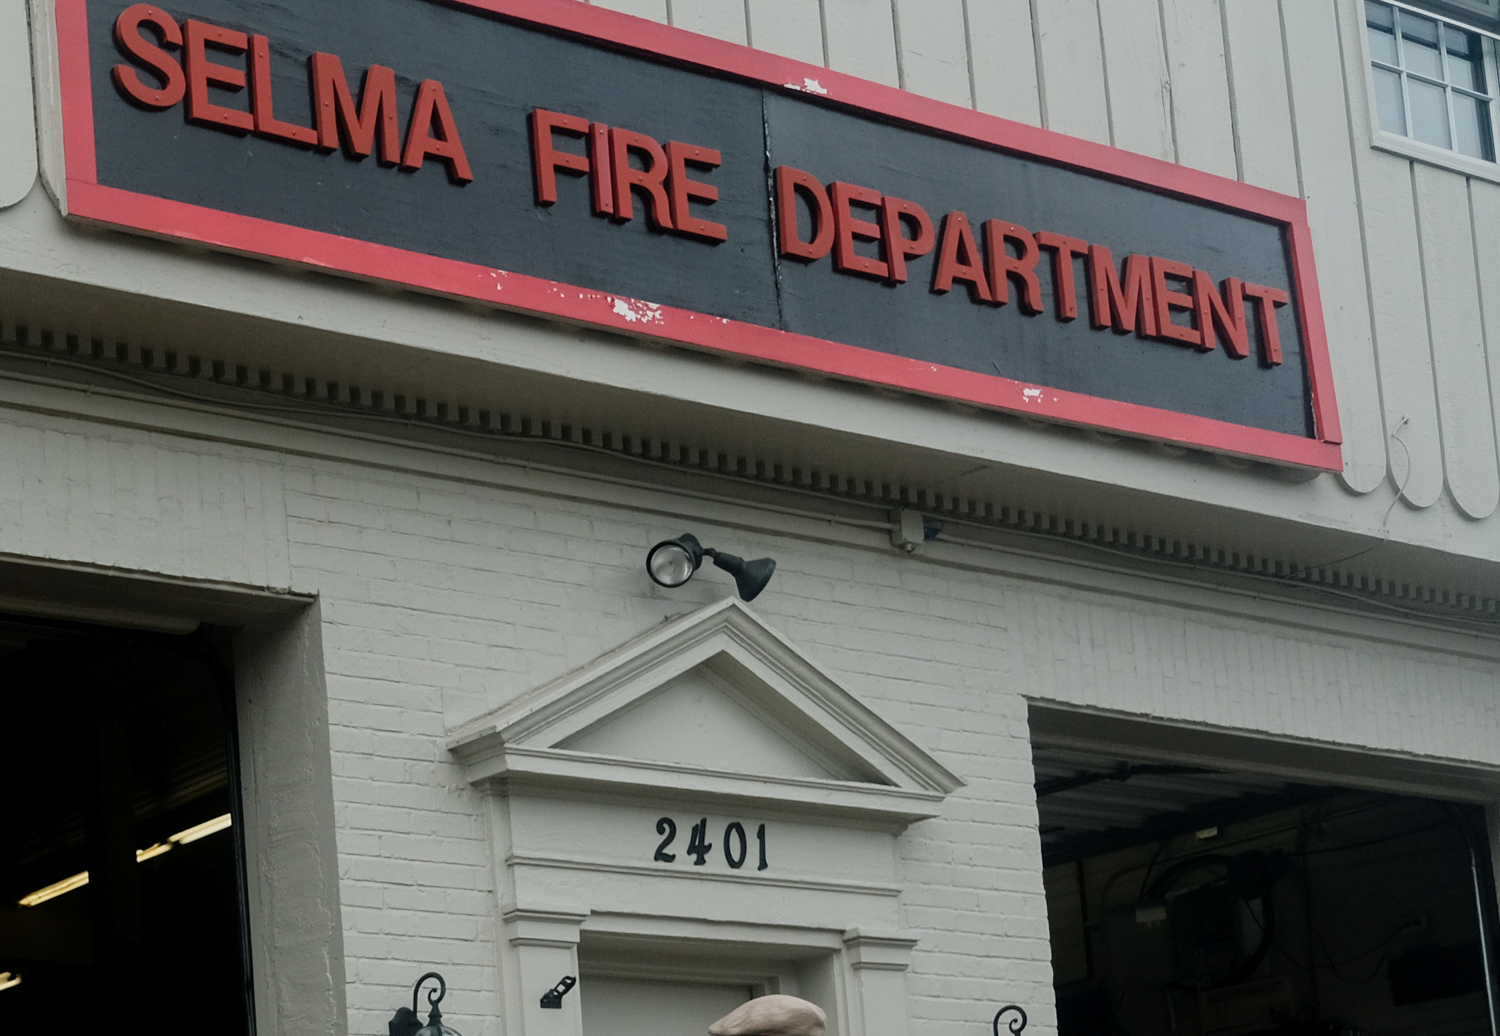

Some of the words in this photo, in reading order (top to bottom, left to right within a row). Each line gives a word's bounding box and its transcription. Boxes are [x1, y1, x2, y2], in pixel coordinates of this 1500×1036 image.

[113, 3, 473, 186] SELMA
[530, 107, 728, 244] FIRE
[774, 165, 1288, 368] DEPARTMENT
[654, 817, 768, 871] 2401
